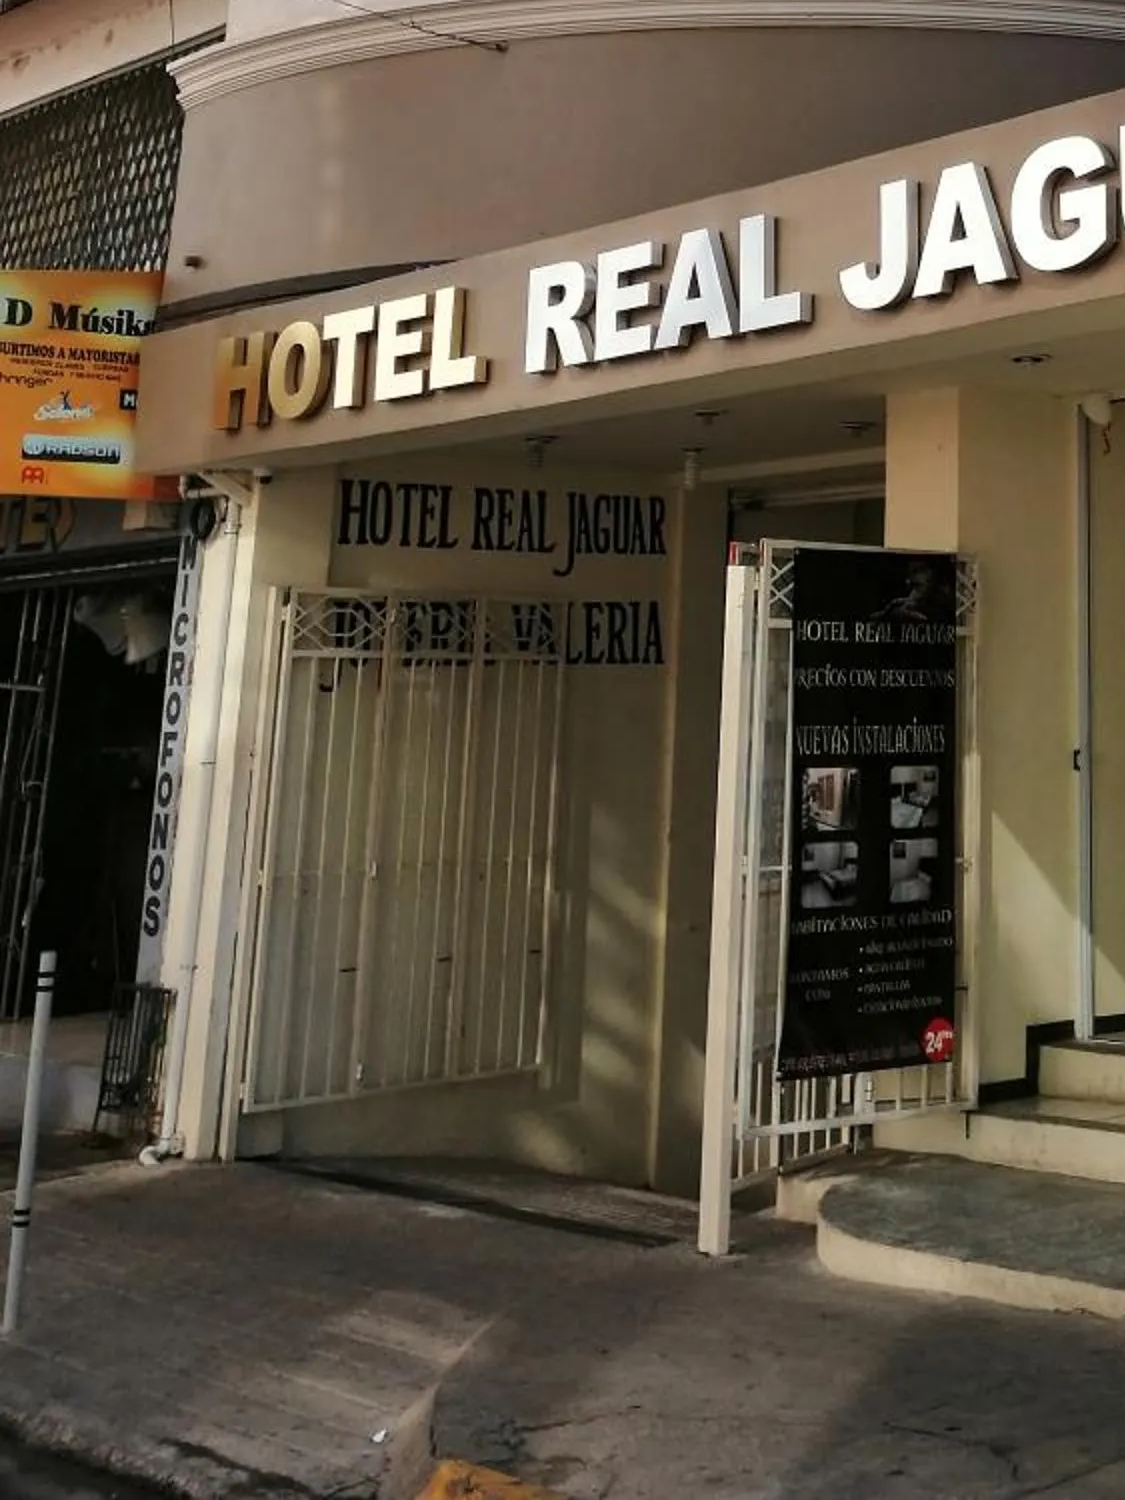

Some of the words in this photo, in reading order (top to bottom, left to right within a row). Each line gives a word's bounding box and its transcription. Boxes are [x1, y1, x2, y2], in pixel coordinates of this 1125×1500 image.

[212, 285, 488, 432] HOTEL
[524, 213, 813, 375] REAL
[337, 479, 459, 548] HOTEL
[471, 487, 559, 553] REAL
[553, 491, 667, 577] JAGUAR
[796, 619, 849, 643] HOTEL
[855, 621, 895, 643] REAL
